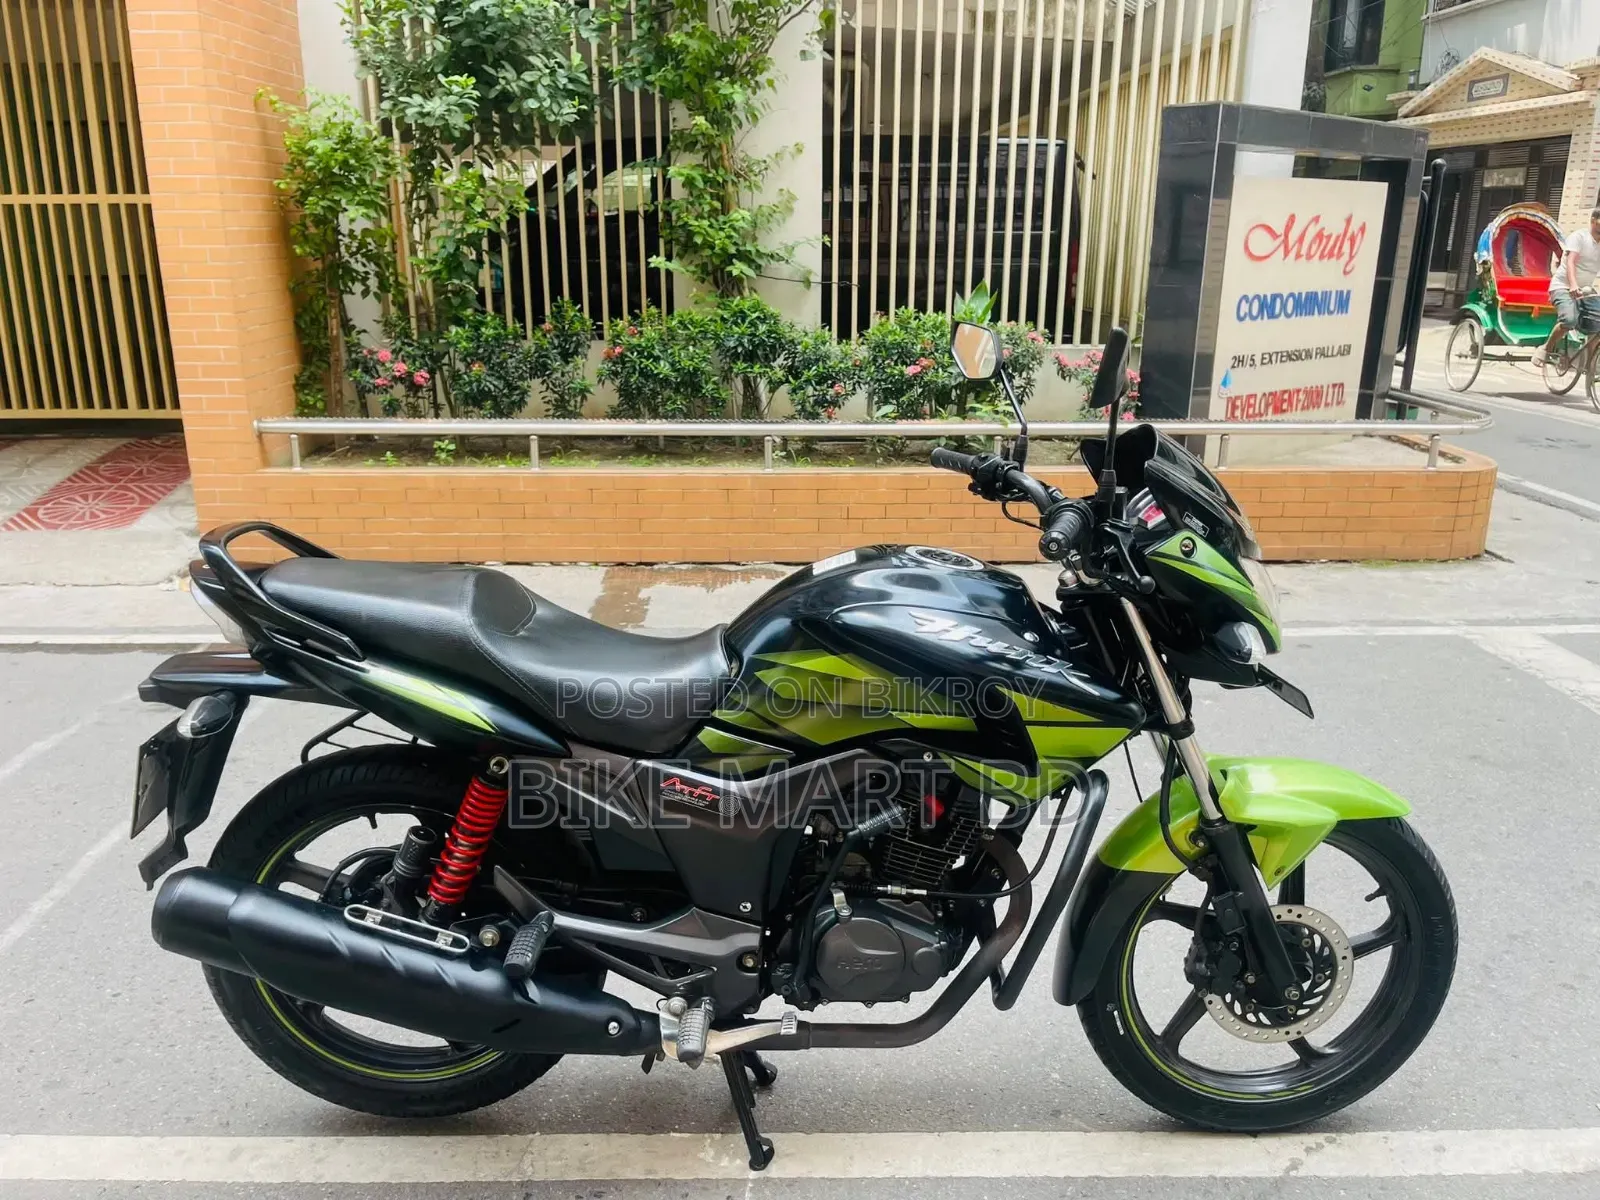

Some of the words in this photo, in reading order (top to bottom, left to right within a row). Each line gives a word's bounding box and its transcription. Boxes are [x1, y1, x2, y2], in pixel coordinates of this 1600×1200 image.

[1243, 213, 1366, 276] Mouly
[1236, 290, 1352, 322] CONDOMINIUM
[1260, 347, 1314, 366] EXTENSION
[1314, 344, 1352, 360] PALLABI
[1324, 382, 1346, 407] LTD.
